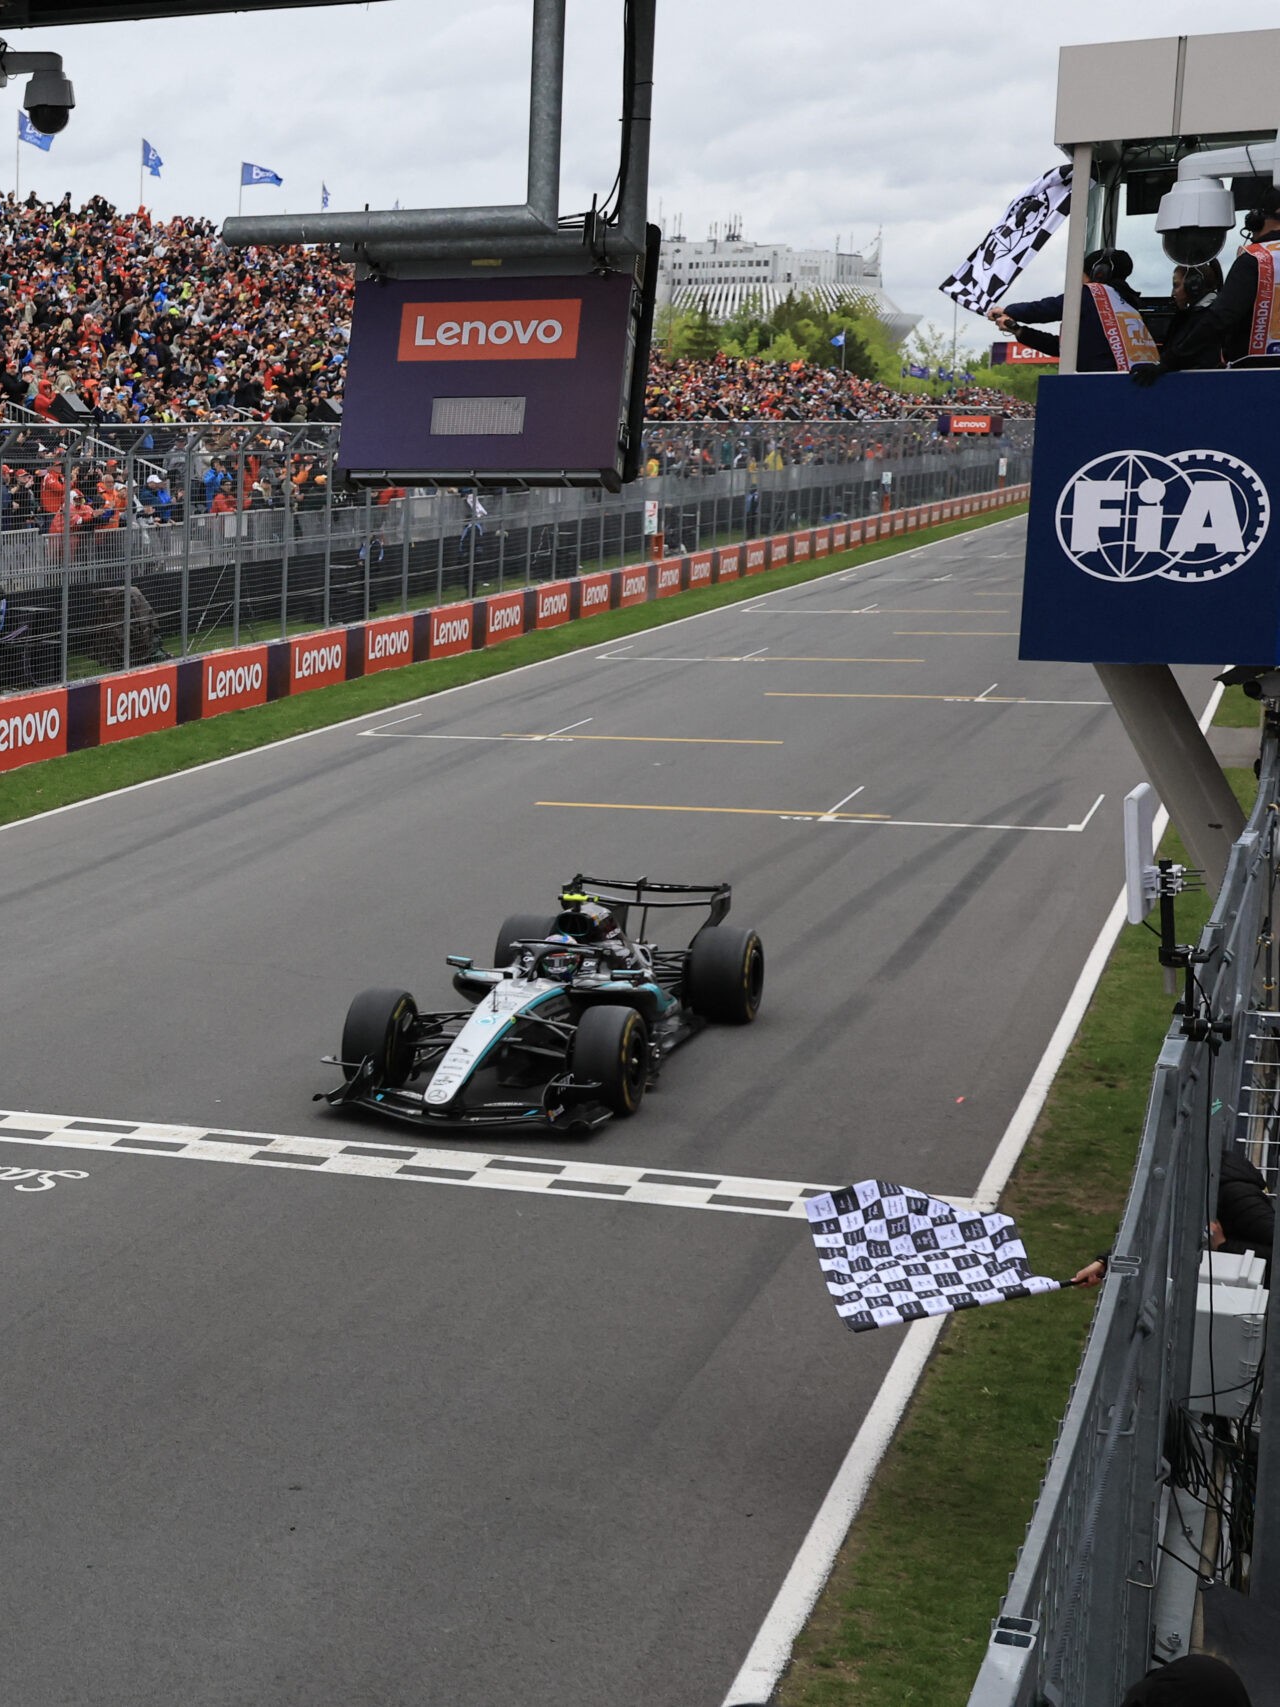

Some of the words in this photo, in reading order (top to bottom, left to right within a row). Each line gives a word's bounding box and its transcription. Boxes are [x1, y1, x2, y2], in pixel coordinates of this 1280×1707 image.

[414, 315, 563, 346] Lenovo
[1252, 300, 1270, 349] CANADA
[1012, 345, 1051, 359] Len
[953, 419, 987, 428] Lenovo
[583, 583, 609, 607] Lenovo
[622, 575, 647, 597] Lenovo
[489, 605, 521, 633] Lenovo
[539, 592, 568, 618] Lenovo
[368, 629, 410, 660] Lenovo
[433, 618, 469, 646] Lenovo
[295, 644, 342, 679] Lenovo
[208, 663, 263, 701] Lenovo
[107, 683, 171, 726] Lenovo
